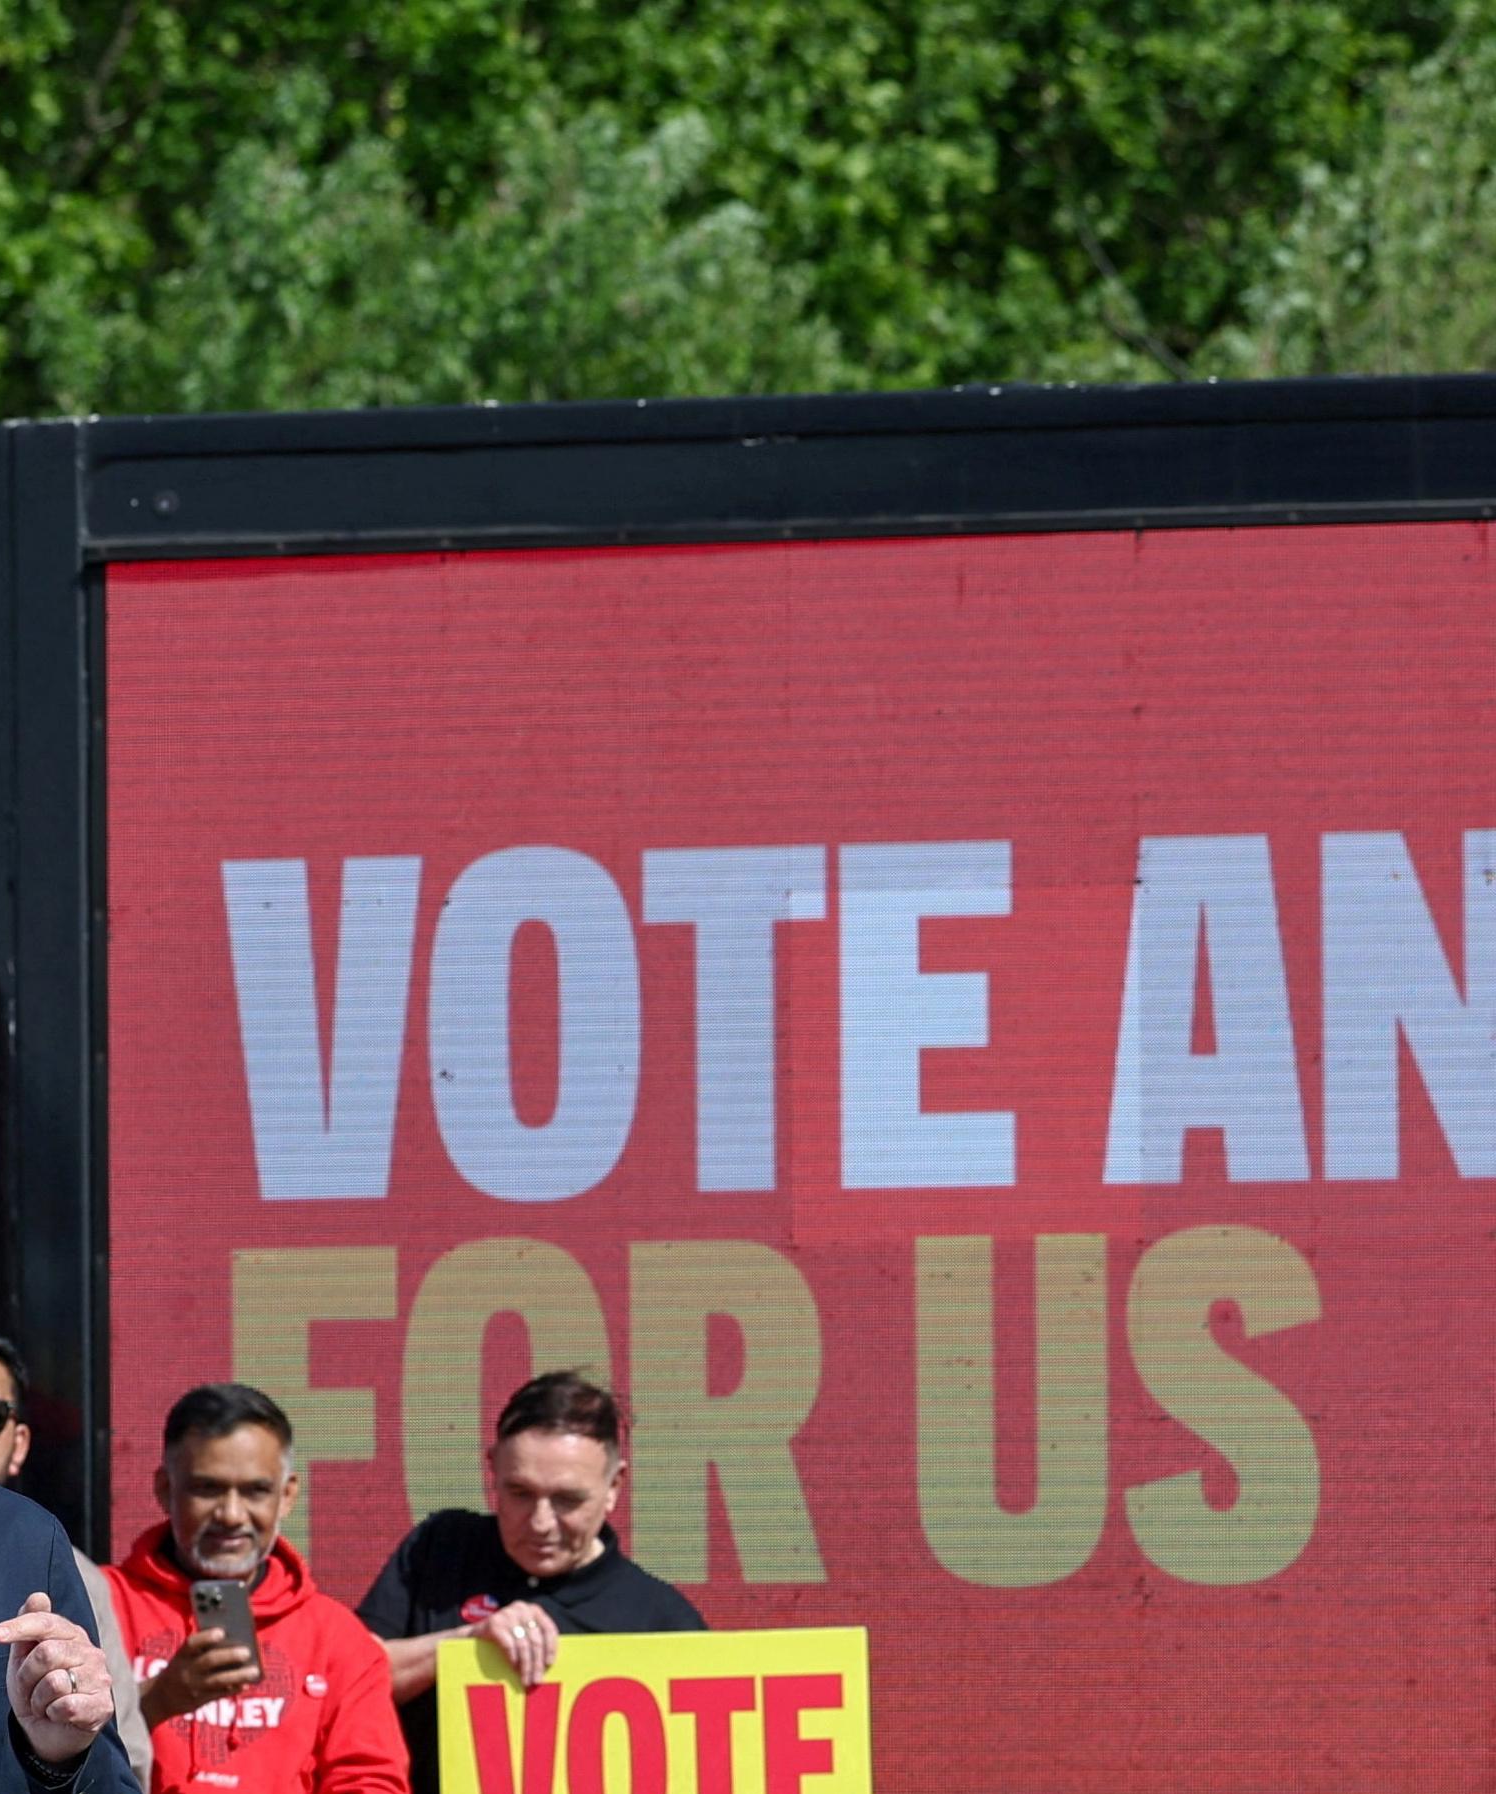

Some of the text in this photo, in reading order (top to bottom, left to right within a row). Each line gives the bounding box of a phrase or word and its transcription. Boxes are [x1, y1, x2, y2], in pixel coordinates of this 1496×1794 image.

[221, 838, 1016, 1203] VOTE
[229, 1224, 1325, 1589] FOR US
